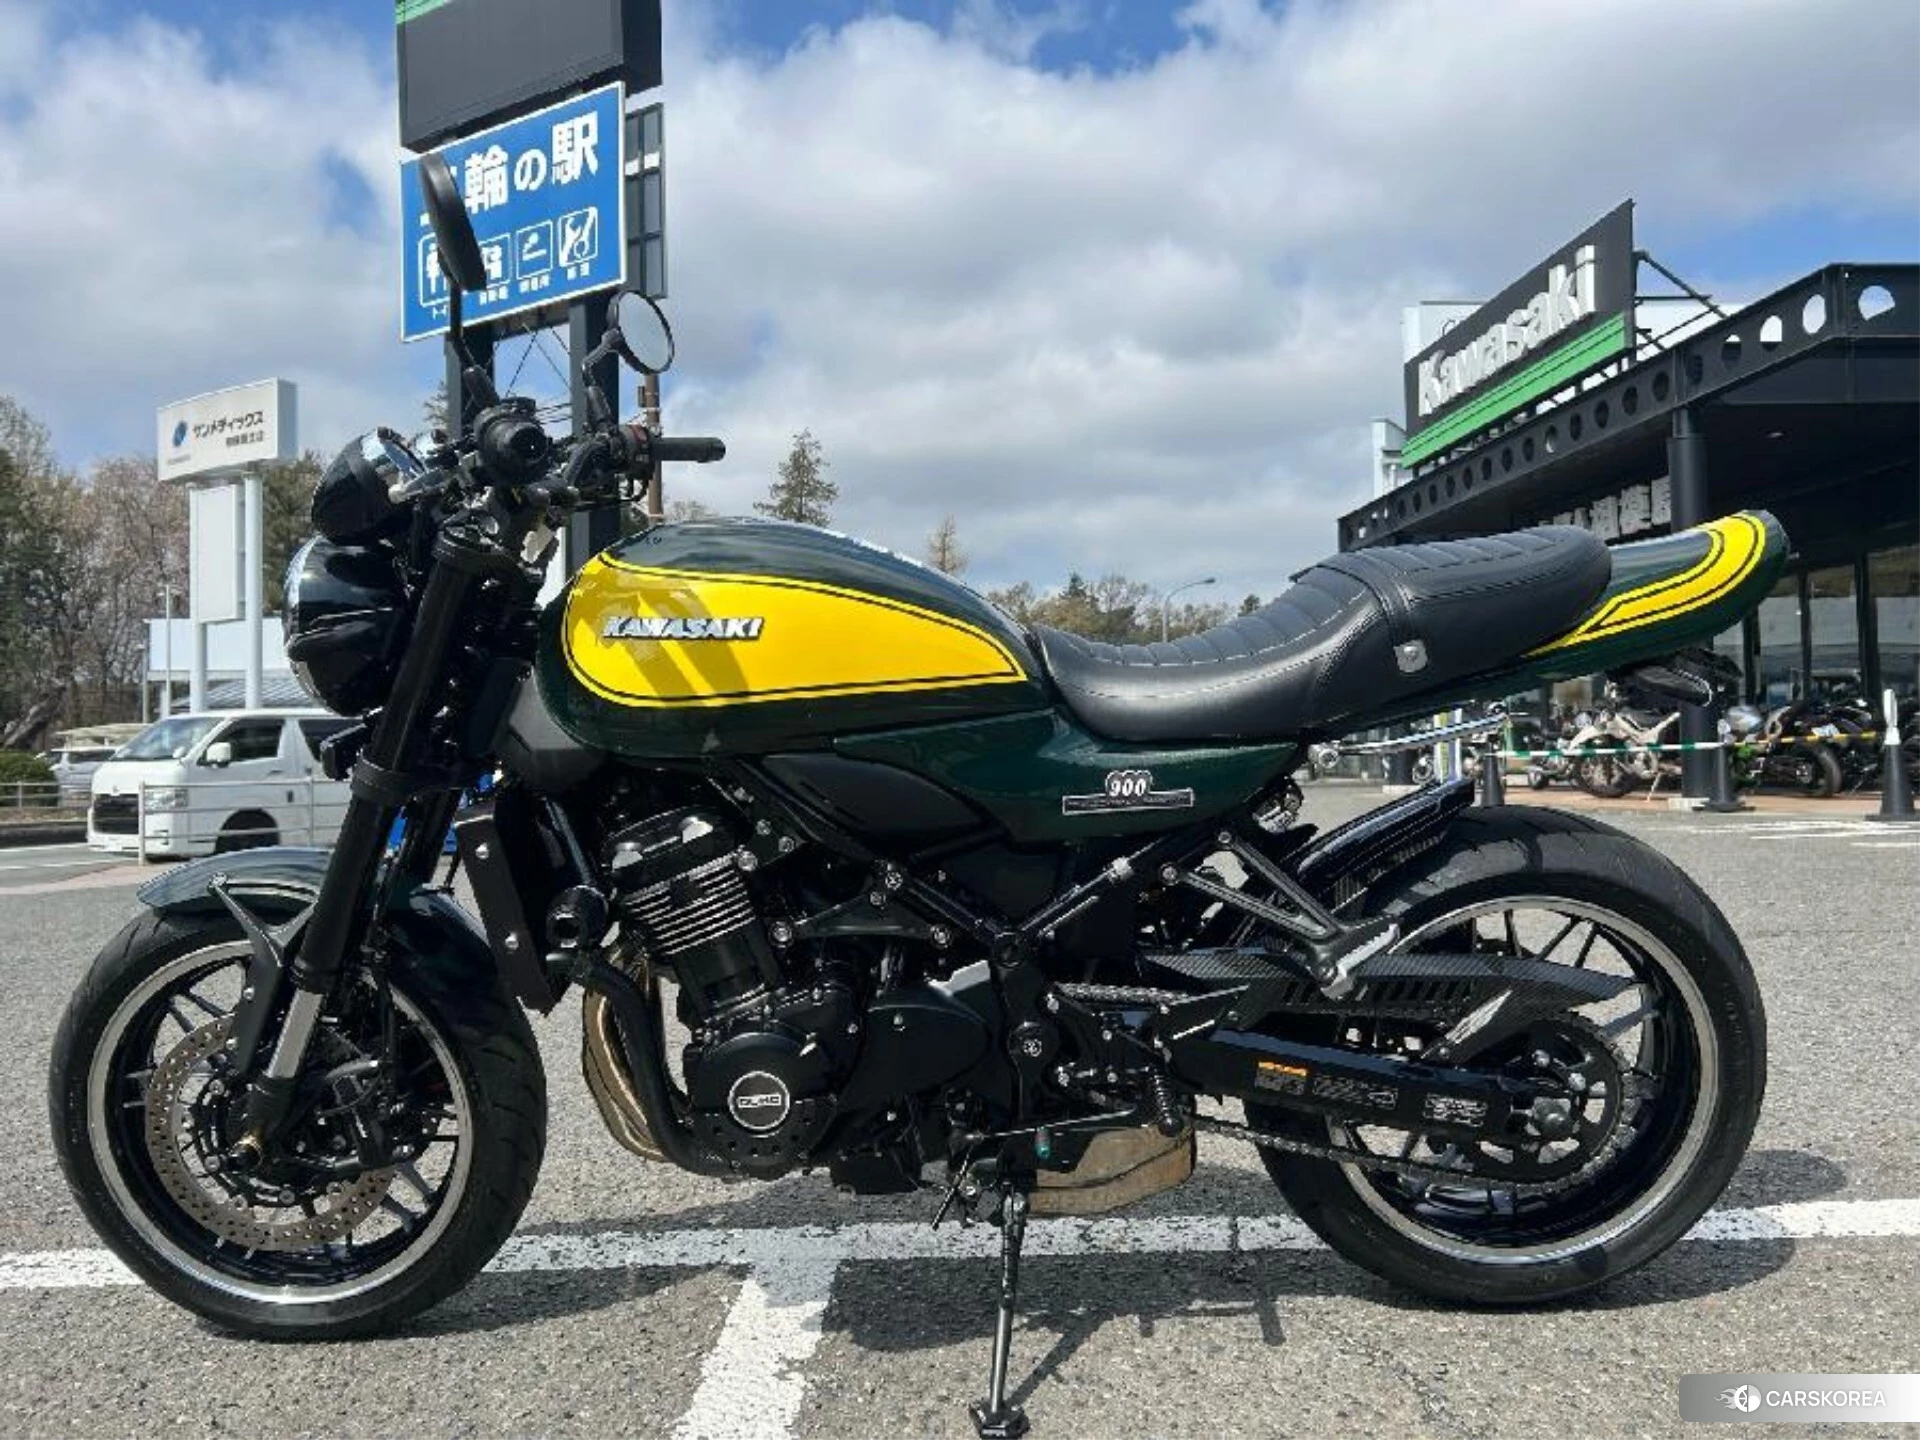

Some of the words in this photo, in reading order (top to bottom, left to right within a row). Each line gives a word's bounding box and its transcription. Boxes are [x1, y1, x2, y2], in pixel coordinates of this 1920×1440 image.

[420, 111, 599, 227] 輪の駅
[1418, 245, 1595, 418] Kawasaki
[602, 616, 764, 640] KAWASAKI
[1108, 778, 1147, 797] 900
